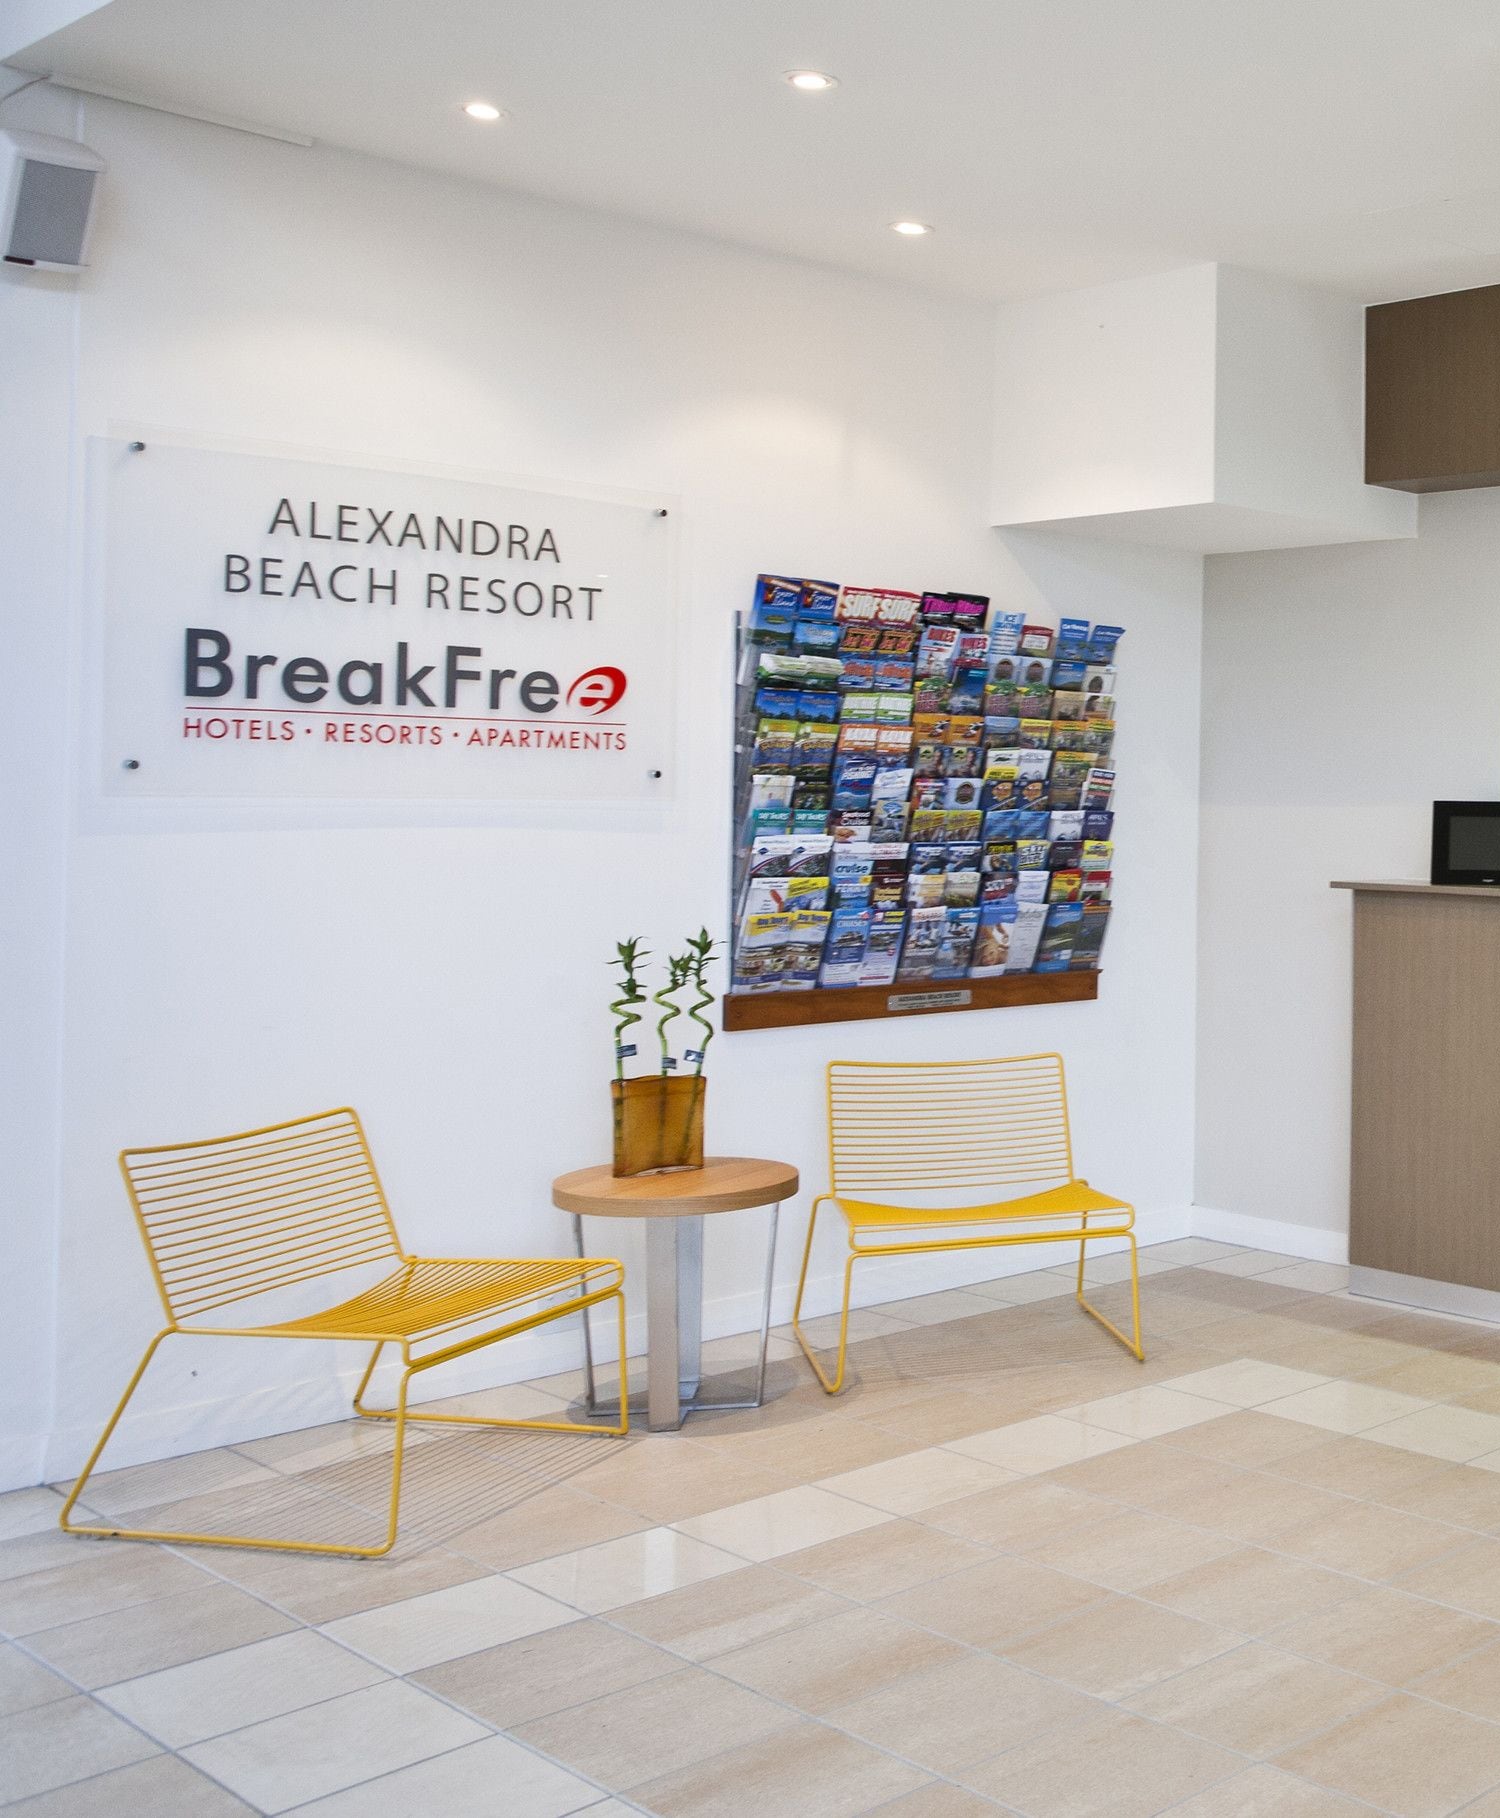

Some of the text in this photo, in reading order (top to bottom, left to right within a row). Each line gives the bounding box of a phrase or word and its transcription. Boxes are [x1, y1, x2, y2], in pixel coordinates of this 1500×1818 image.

[269, 497, 561, 563] ALEXANDRA
[223, 553, 603, 621] BEACH RESORT
[184, 627, 627, 717] BreakFree
[183, 717, 627, 751] HOTELS RESORTS APARTMENTS
[835, 864, 868, 873] cruise
